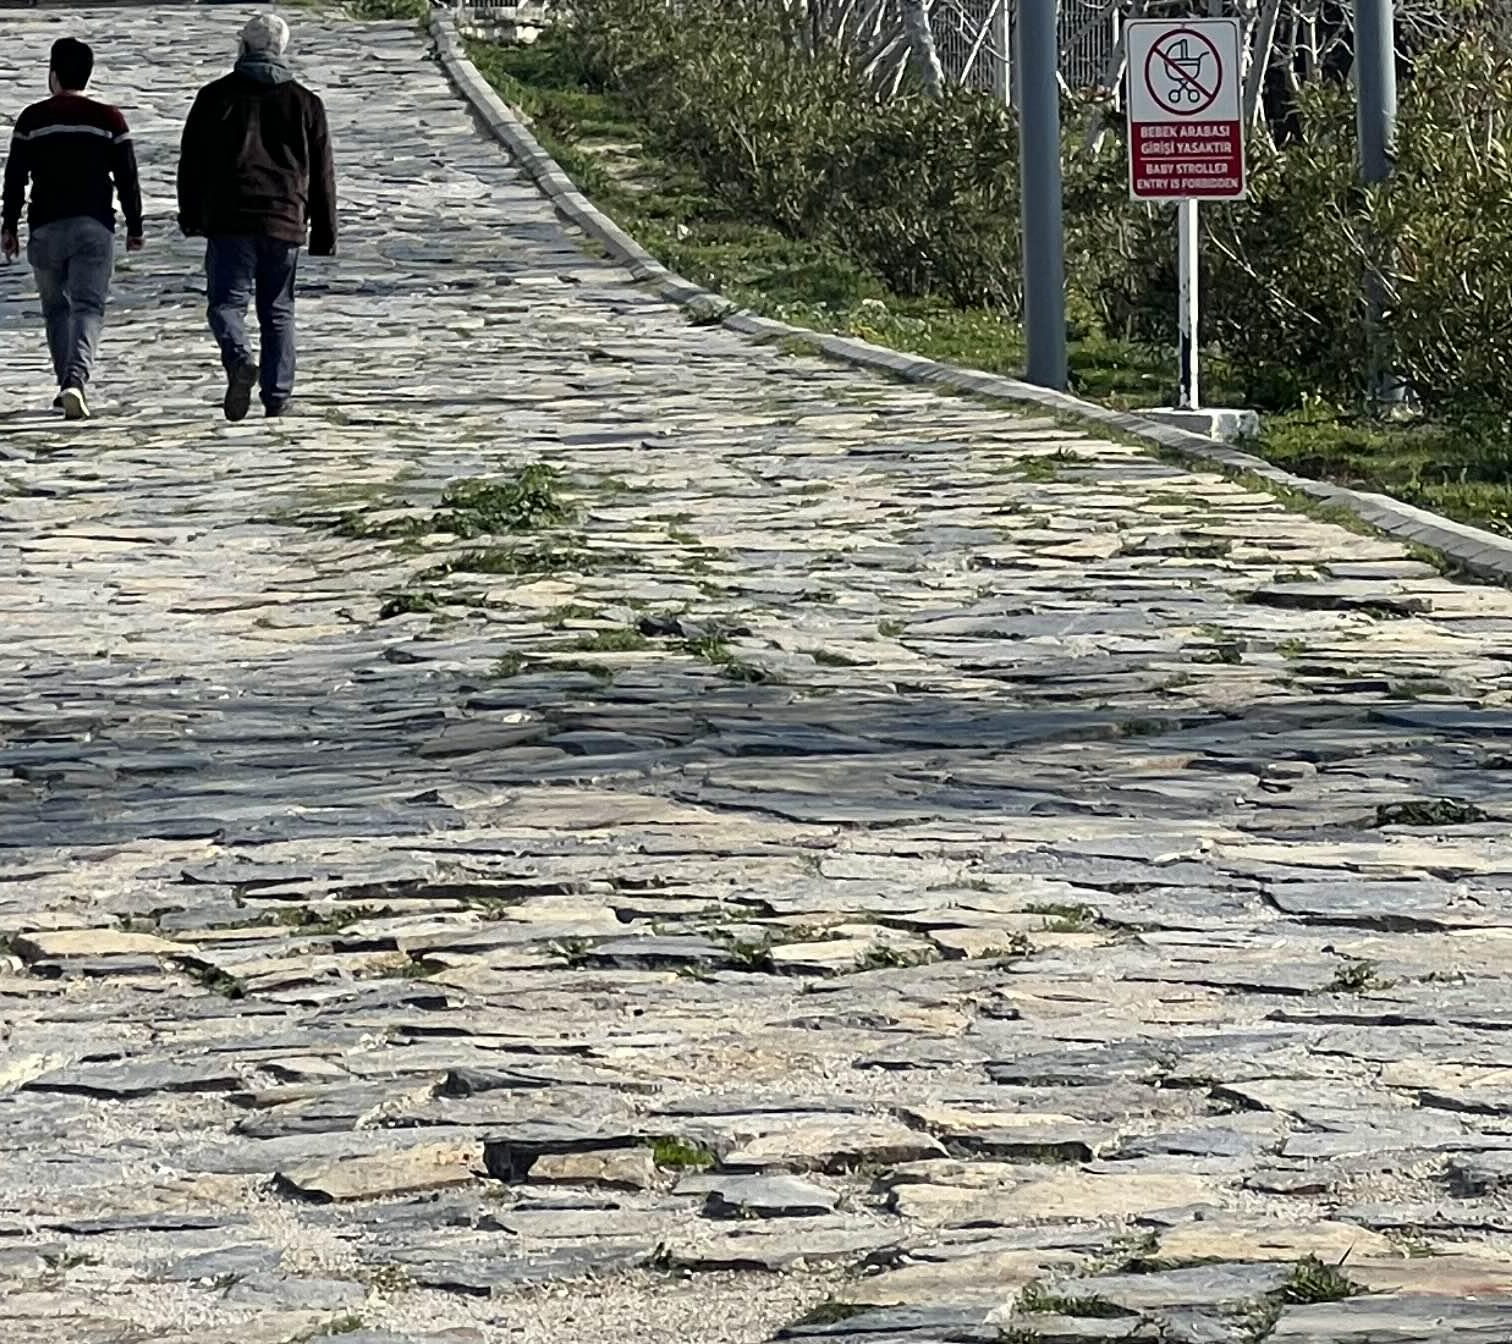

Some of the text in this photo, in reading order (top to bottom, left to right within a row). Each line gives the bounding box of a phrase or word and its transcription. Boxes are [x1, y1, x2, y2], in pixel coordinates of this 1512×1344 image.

[1140, 125, 1230, 139] BEBEK ARABASI
[1176, 141, 1232, 154] YASAKTIR
[1145, 162, 1228, 175] BABY STROLLER
[1136, 178, 1168, 190] ENTRY
[1170, 178, 1180, 189] IS
